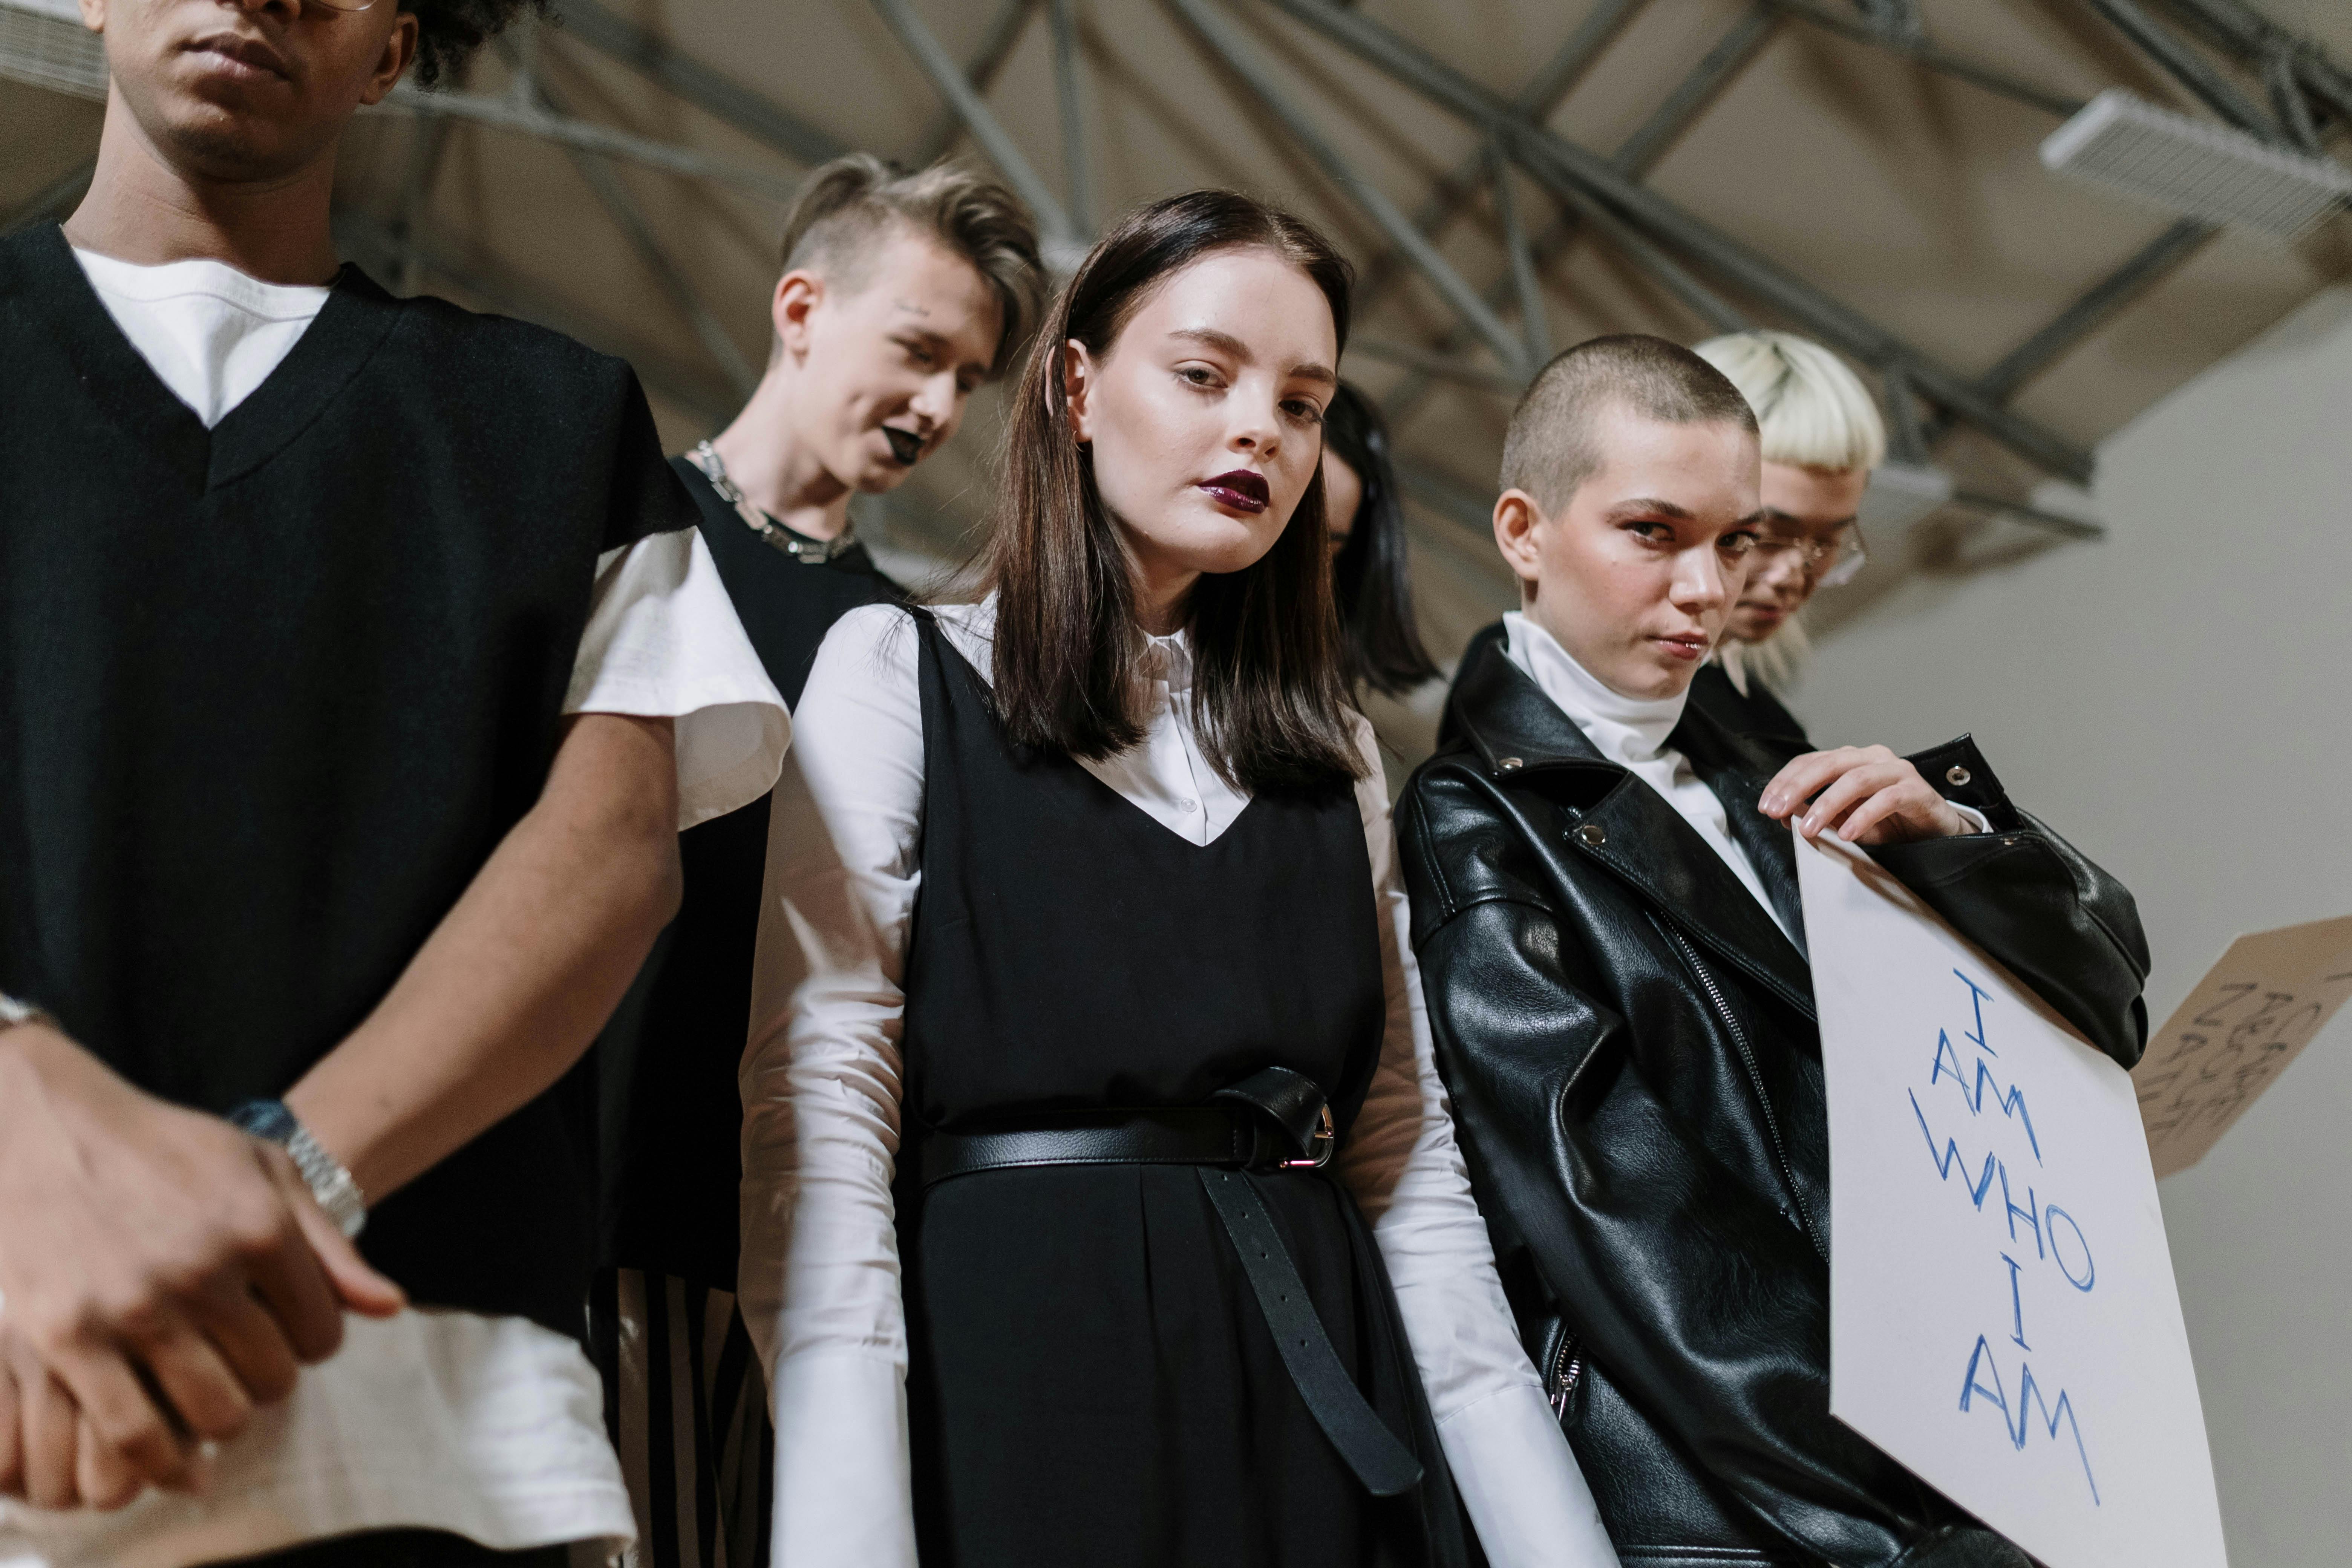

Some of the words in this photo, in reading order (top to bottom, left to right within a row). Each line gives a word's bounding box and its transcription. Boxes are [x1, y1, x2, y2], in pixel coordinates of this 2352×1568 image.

[1953, 968, 1995, 1057] I
[2150, 992, 2293, 1144] ABOUT
[1931, 1027, 2043, 1168] AM
[1908, 1086, 2095, 1293] WHO
[2001, 1251, 2031, 1351] I
[1959, 1334, 2100, 1507] AM
